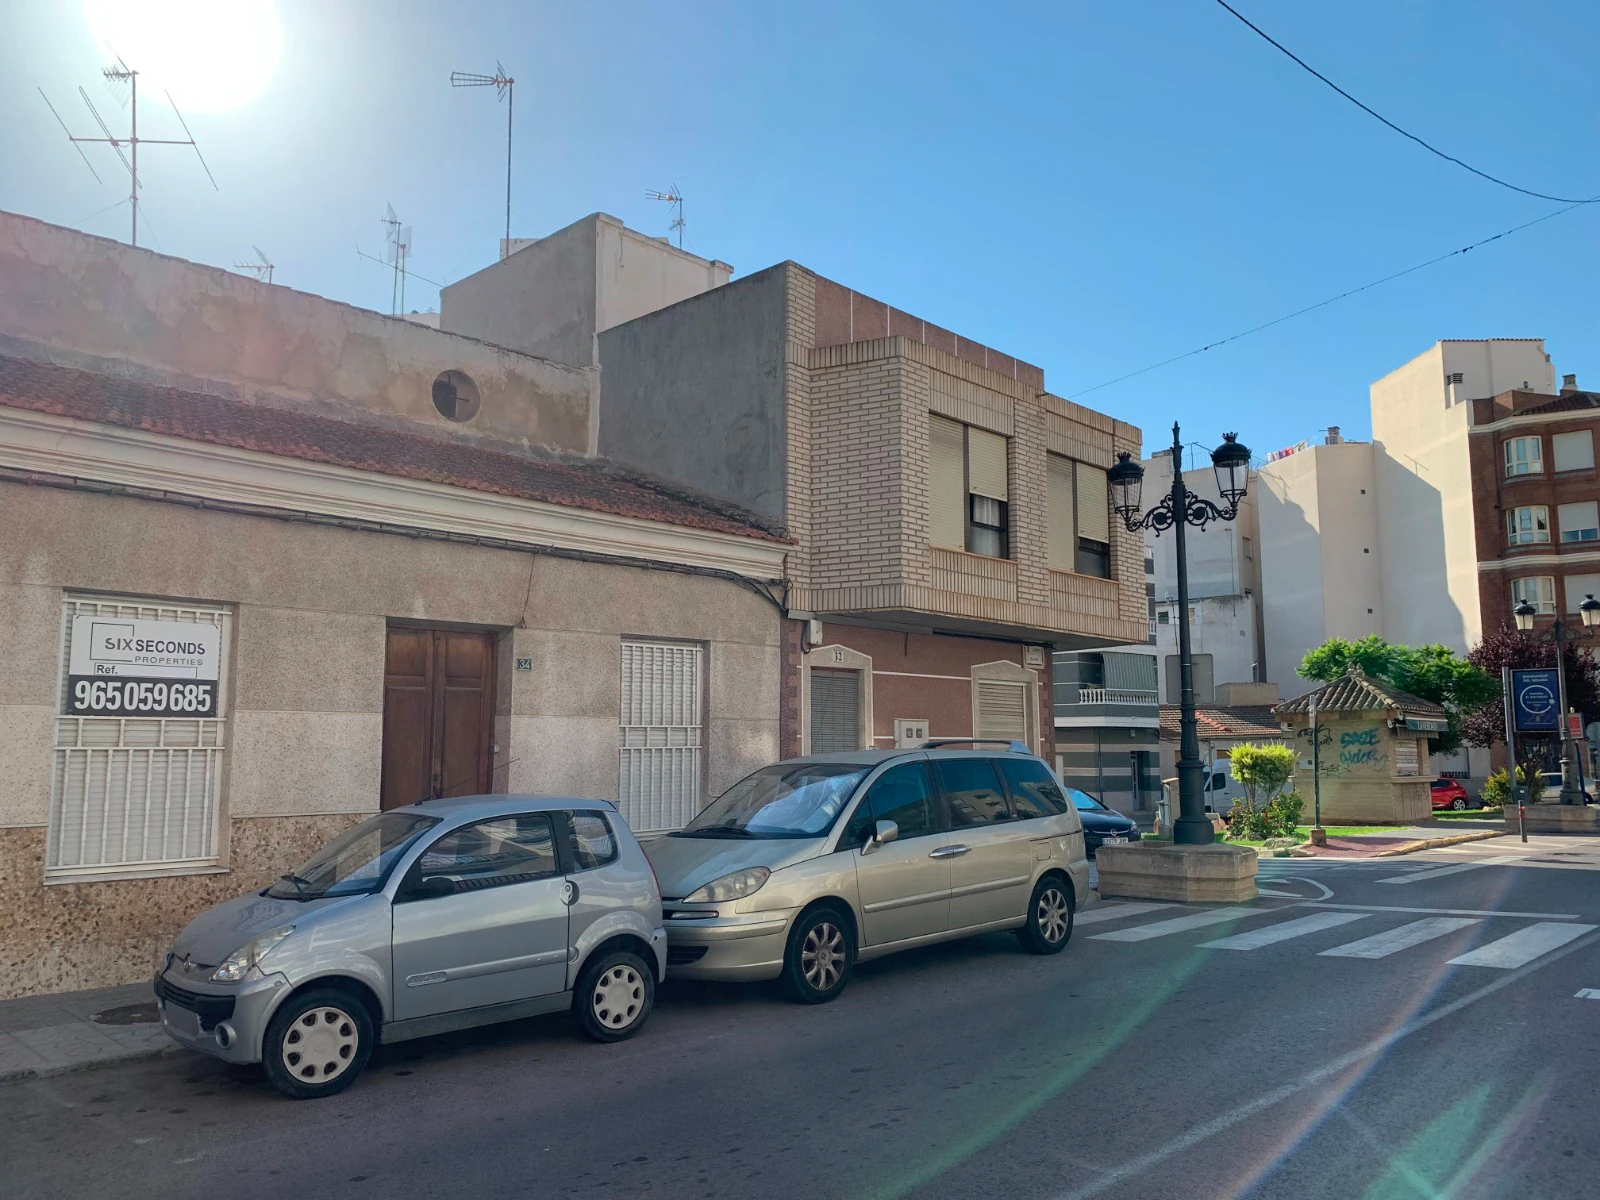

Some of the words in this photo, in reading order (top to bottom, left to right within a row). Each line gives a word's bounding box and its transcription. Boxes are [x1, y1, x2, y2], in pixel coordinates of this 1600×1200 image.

[134, 655, 204, 666] PROPERTIES
[834, 651, 843, 661] 32
[519, 659, 530, 669] 34
[96, 664, 118, 675] Ref.
